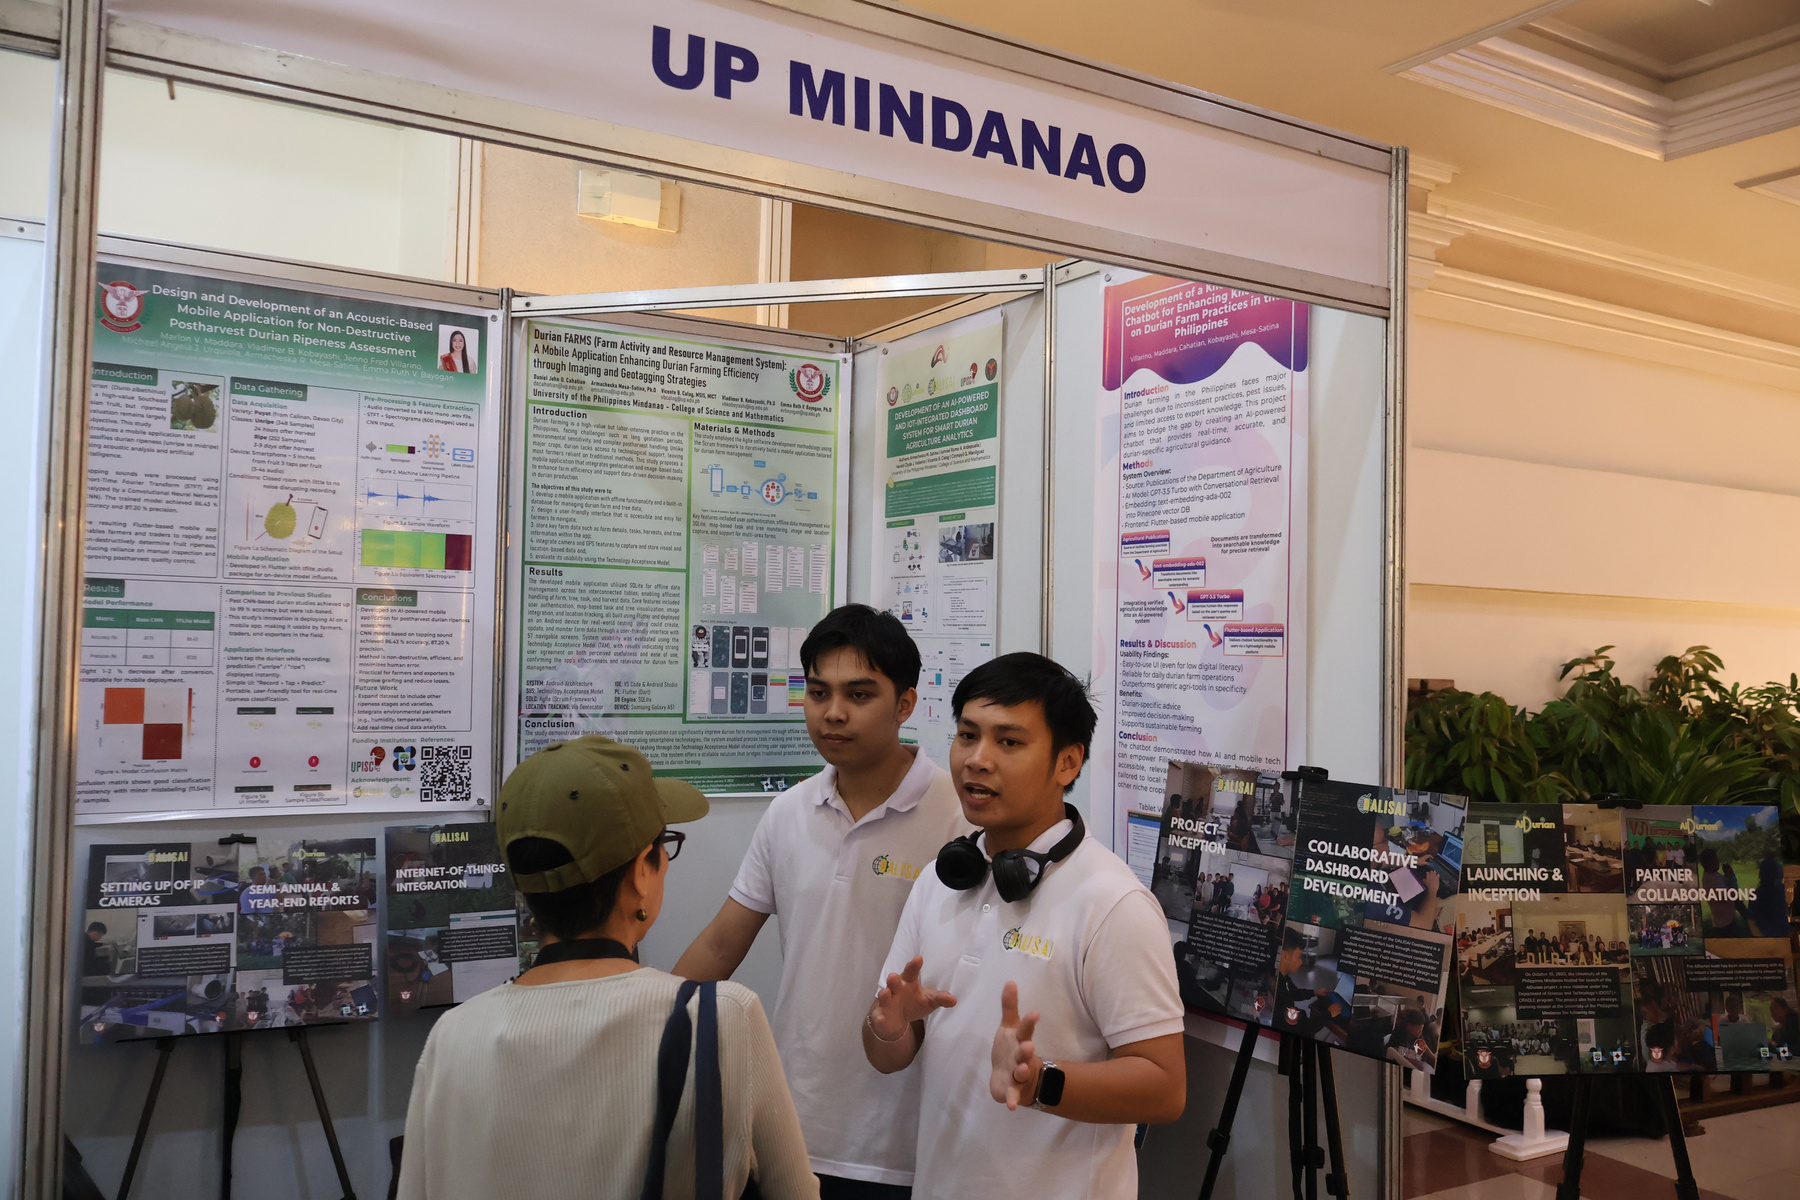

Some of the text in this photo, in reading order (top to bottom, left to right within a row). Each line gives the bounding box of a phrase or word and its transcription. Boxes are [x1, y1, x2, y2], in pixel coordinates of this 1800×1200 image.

[652, 25, 1146, 194] UP MINDANAO
[152, 284, 197, 300] Design
[200, 293, 224, 302] and
[228, 295, 310, 314] Development
[313, 307, 326, 316] of
[346, 312, 432, 330] Acoustic-Based
[1124, 292, 1182, 316] Development
[1185, 288, 1195, 298] of
[1197, 287, 1207, 295] a
[1125, 310, 1159, 326] Chatbot
[1161, 307, 1174, 316] for
[1177, 293, 1228, 312] Enhancing
[177, 304, 411, 342] Mobile Application for Non-Destructive
[1130, 328, 1141, 336] on
[1144, 320, 1173, 333] Durian
[1175, 313, 1199, 325] Farm
[1202, 300, 1248, 318] Practices
[1250, 297, 1260, 306] in
[1174, 318, 1228, 337] Philippines
[169, 318, 416, 357] Postharvest Durian Ripeness Assessment
[1130, 323, 1279, 361] Villarino, Maddara, Cahatian, Kobayashi, Mesa-Satina
[534, 328, 786, 371] Durian FARMS (Farm Activity and Resource Management System):
[533, 344, 759, 382] A Mobile Application Enhancing Durian Farming Efficiency
[92, 365, 152, 380] Introduction
[533, 359, 706, 388] through Imaging and Geotagging Strategies
[234, 382, 303, 398] Data Gathering
[1124, 400, 1142, 410] Durian
[1146, 395, 1169, 404] farming
[1201, 382, 1236, 393] Philippines
[1265, 372, 1286, 381] major
[1124, 385, 1168, 399] Introduction
[533, 389, 568, 401] University
[593, 395, 630, 406] Philippines
[632, 399, 664, 409] Mindanao
[671, 403, 695, 414] College
[705, 407, 730, 416] Science
[745, 411, 784, 422] Mathematics
[533, 406, 587, 418] Introduction
[894, 391, 989, 420] DEVELOPMENT OF AN AI-POWERED
[895, 403, 988, 430] AND IOT-INTEGRATED DASHBOARD
[694, 422, 731, 433] Materials
[742, 427, 775, 437] Methods
[902, 417, 977, 439] SYSTEM FOR SMART DURIAN
[906, 429, 973, 449] AGRICULTURE ANALYTICS
[1122, 460, 1153, 470] Methods
[1122, 469, 1171, 481] System Overview:
[1145, 477, 1179, 486] Publications
[1198, 470, 1236, 480] Department
[1244, 465, 1282, 475] Agriculture
[529, 567, 563, 576] Results
[84, 584, 120, 594] Results
[361, 593, 412, 601] Conclusions
[1120, 639, 1145, 647] Results
[1154, 640, 1196, 648] Discussion
[1143, 651, 1169, 659] Findings:
[524, 719, 574, 727] Conclusion
[1118, 731, 1156, 741] Conclusion
[351, 761, 374, 772] UPISC
[1170, 817, 1219, 834] PROJECT
[1168, 834, 1226, 855] INCEPTION
[1308, 839, 1418, 868] COLLABORATIVE
[396, 863, 505, 878] INTERNET-OF-THINGS
[1305, 858, 1389, 883] DASHBOARD
[1467, 868, 1548, 880] LAUNCHING
[1636, 869, 1693, 881] PARTNER
[99, 879, 205, 892] SETTING UP OF IP
[248, 883, 328, 894] SEMI-ANNUAL
[396, 878, 468, 891] INTEGRATION
[1303, 877, 1400, 906] DEVELOPMENT
[98, 895, 160, 906] CAMERAS
[248, 895, 359, 908] YEAR-END REPORTS
[1468, 888, 1540, 901] INCEPTION
[1637, 888, 1757, 901] COLLABORATIONS
